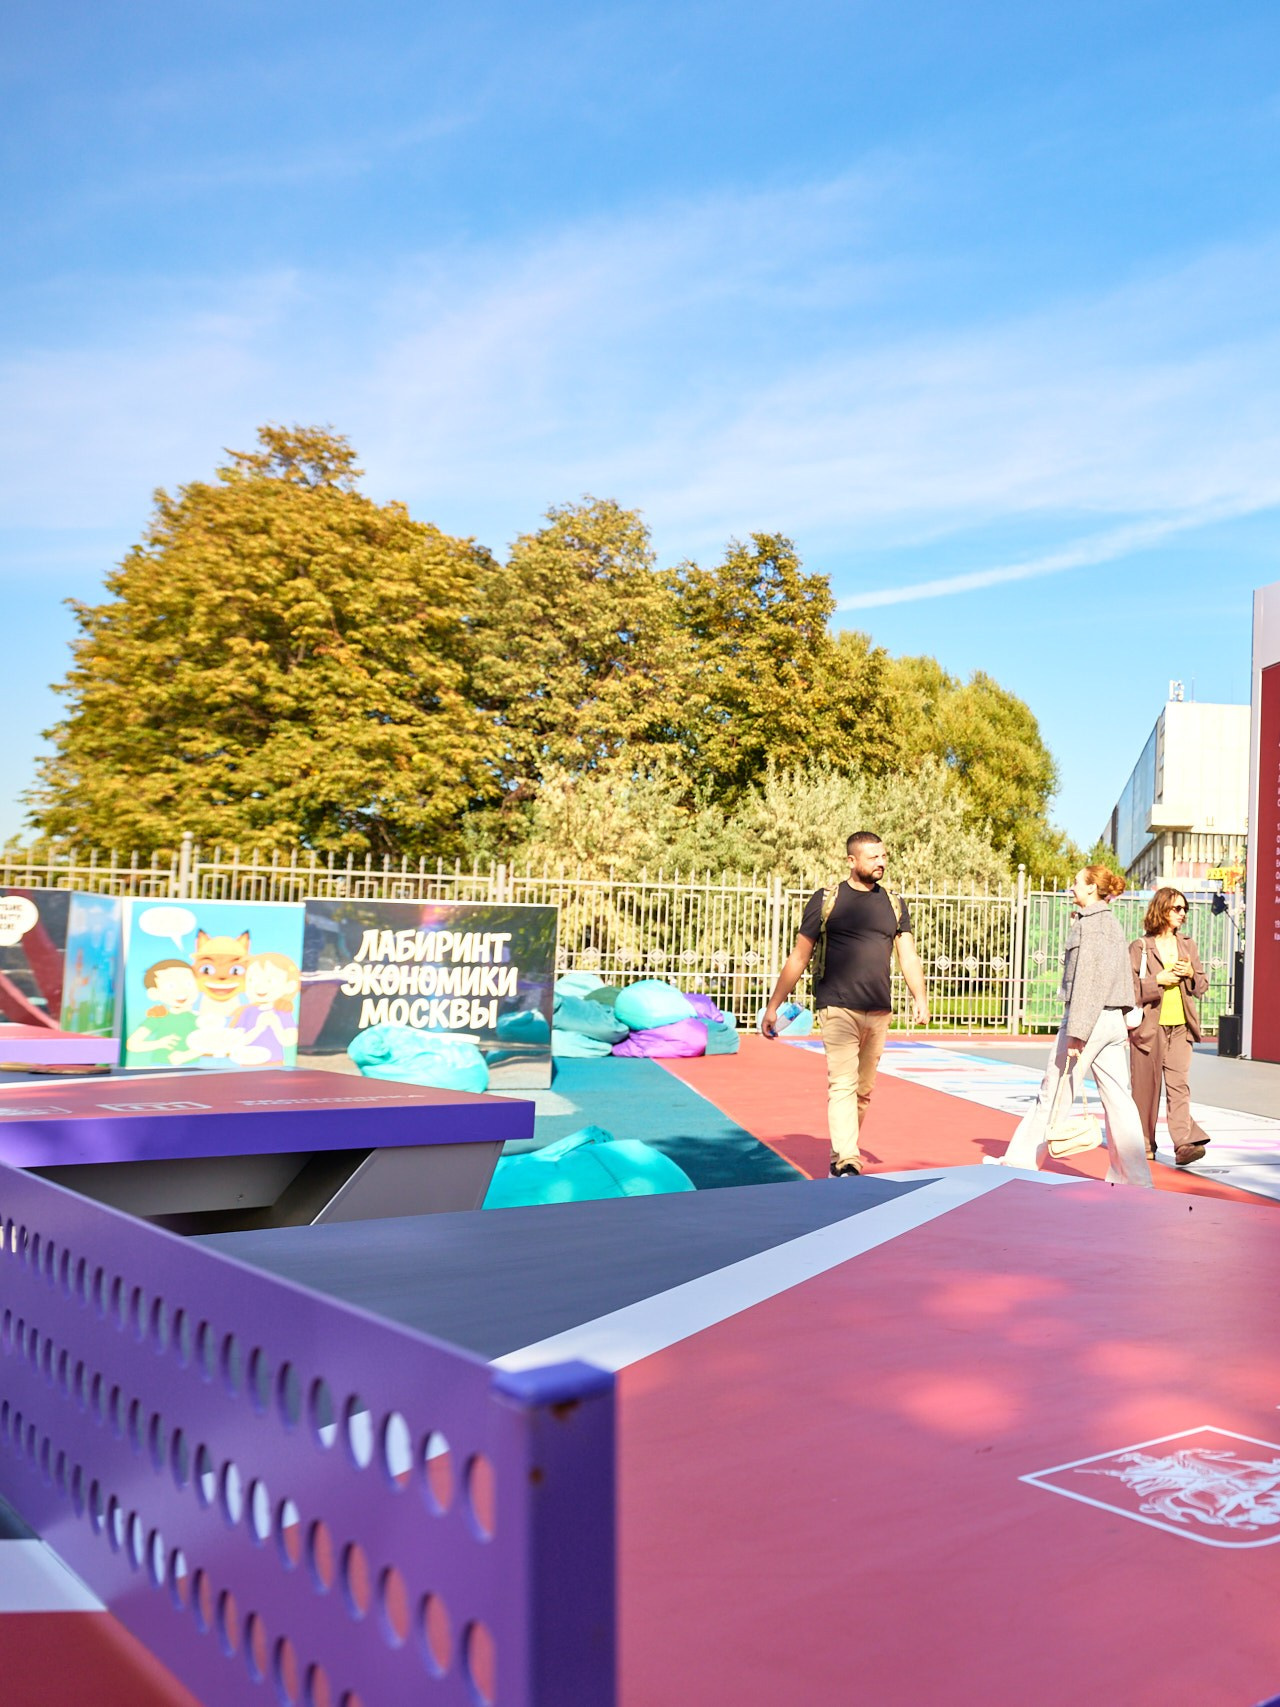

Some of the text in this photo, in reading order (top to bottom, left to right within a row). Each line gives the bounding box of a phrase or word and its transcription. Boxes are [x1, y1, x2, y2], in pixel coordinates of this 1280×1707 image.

[354, 929, 512, 964] ЛАБИРИНТ
[340, 962, 519, 998] ЭКОНОМИКИ
[358, 998, 498, 1030] МОСКВЫ
